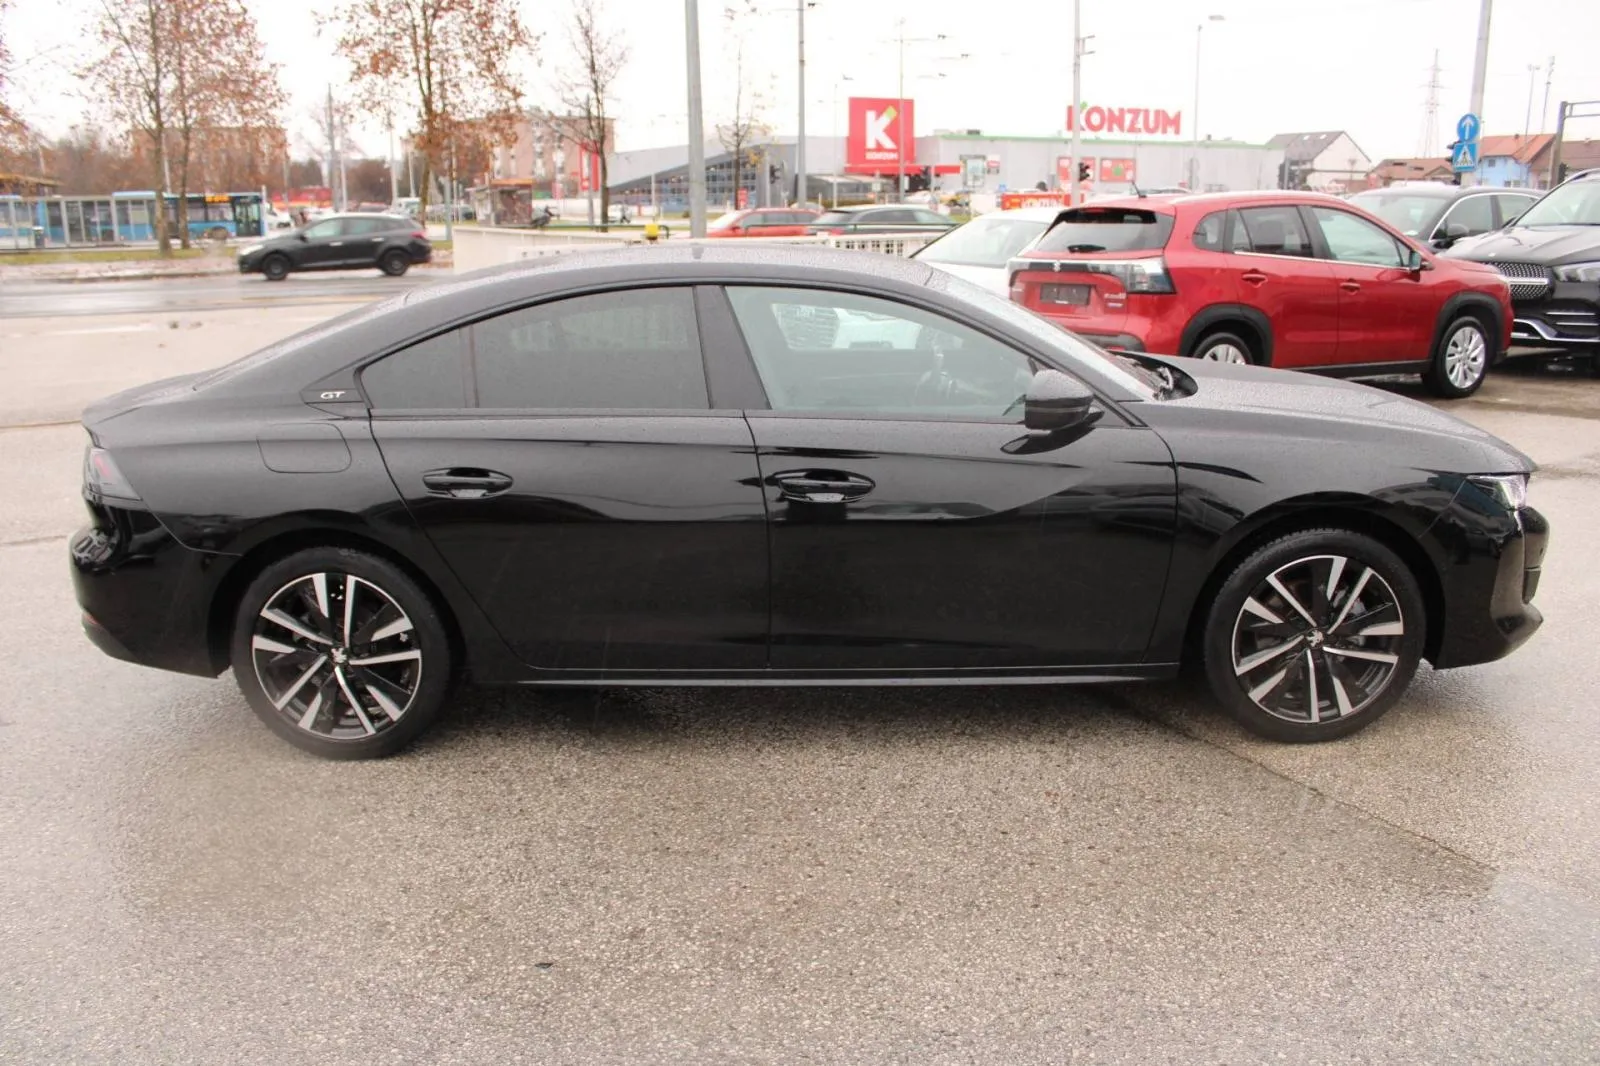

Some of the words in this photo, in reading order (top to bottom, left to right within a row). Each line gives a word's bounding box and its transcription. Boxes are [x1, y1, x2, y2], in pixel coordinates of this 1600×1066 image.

[865, 105, 898, 149] K
[1066, 101, 1181, 135] KONZUM
[320, 391, 345, 399] GT
